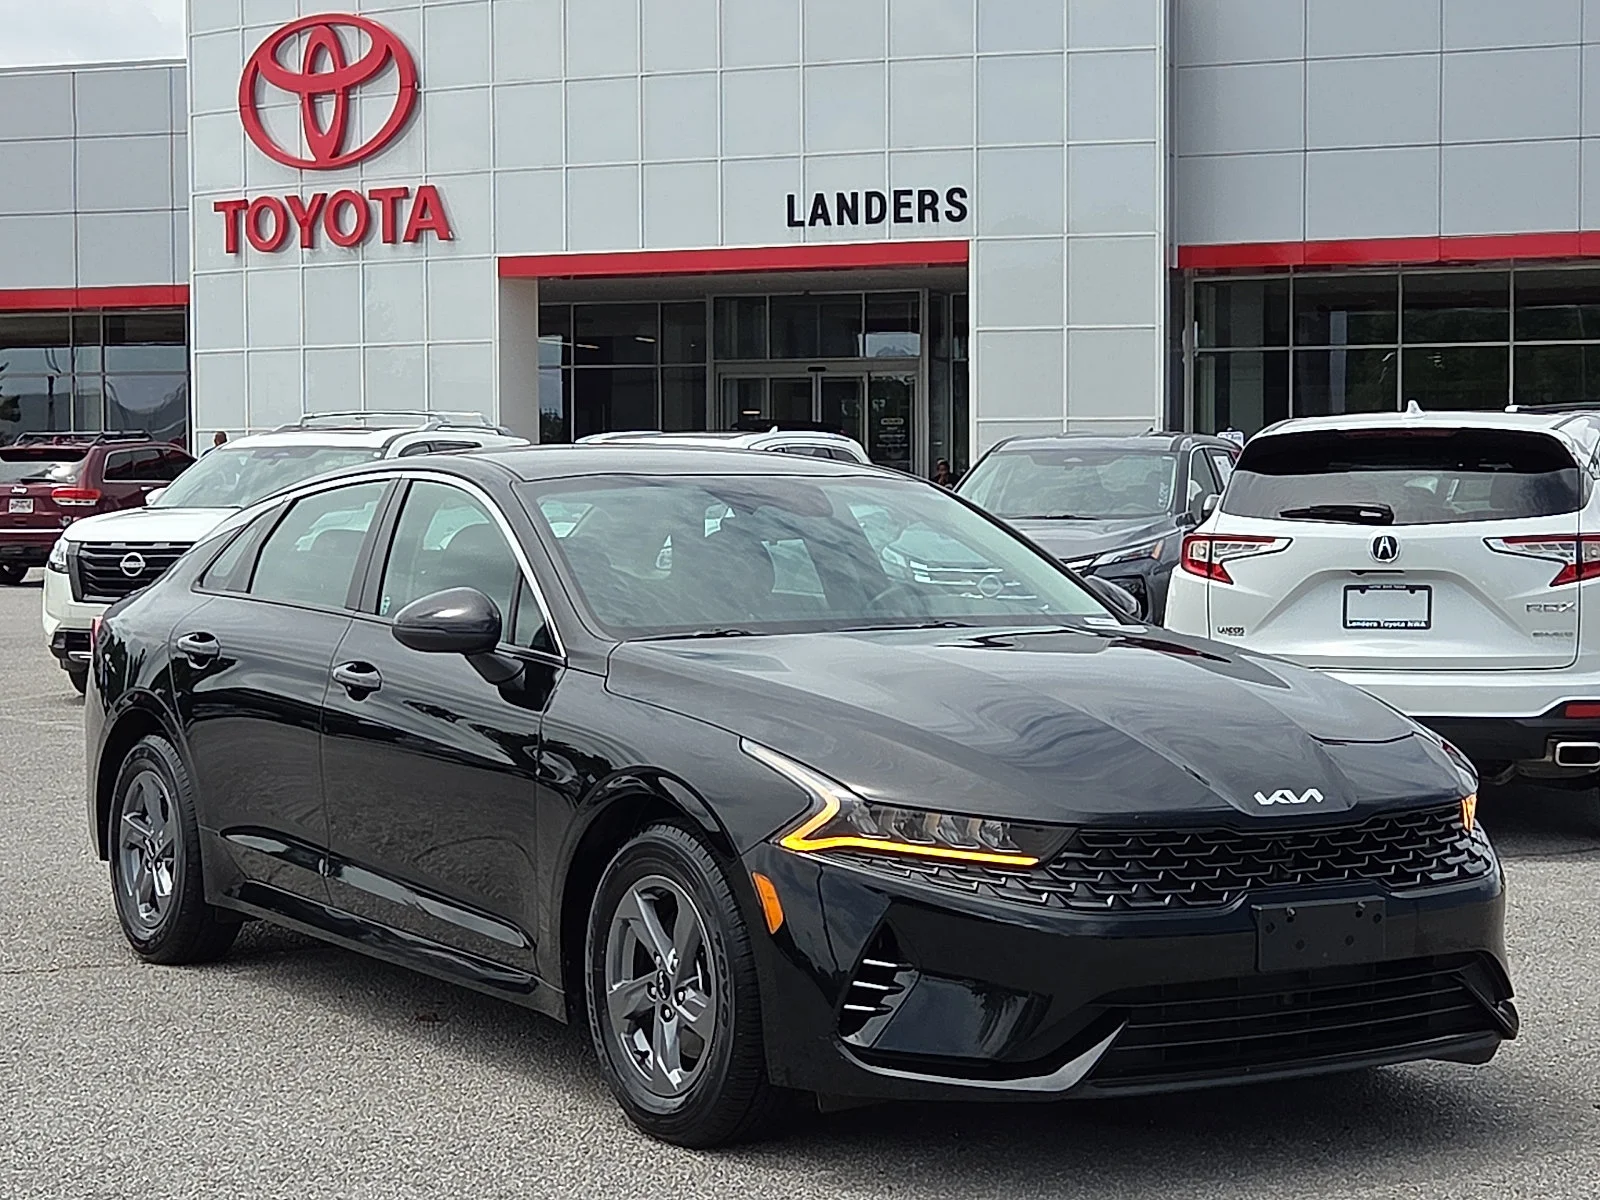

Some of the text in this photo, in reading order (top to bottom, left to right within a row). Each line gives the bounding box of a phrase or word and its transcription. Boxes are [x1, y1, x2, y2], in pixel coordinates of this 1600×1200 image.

[213, 184, 453, 254] TOYOTA
[786, 187, 968, 228] LANDERS
[1253, 788, 1325, 806] KIA
